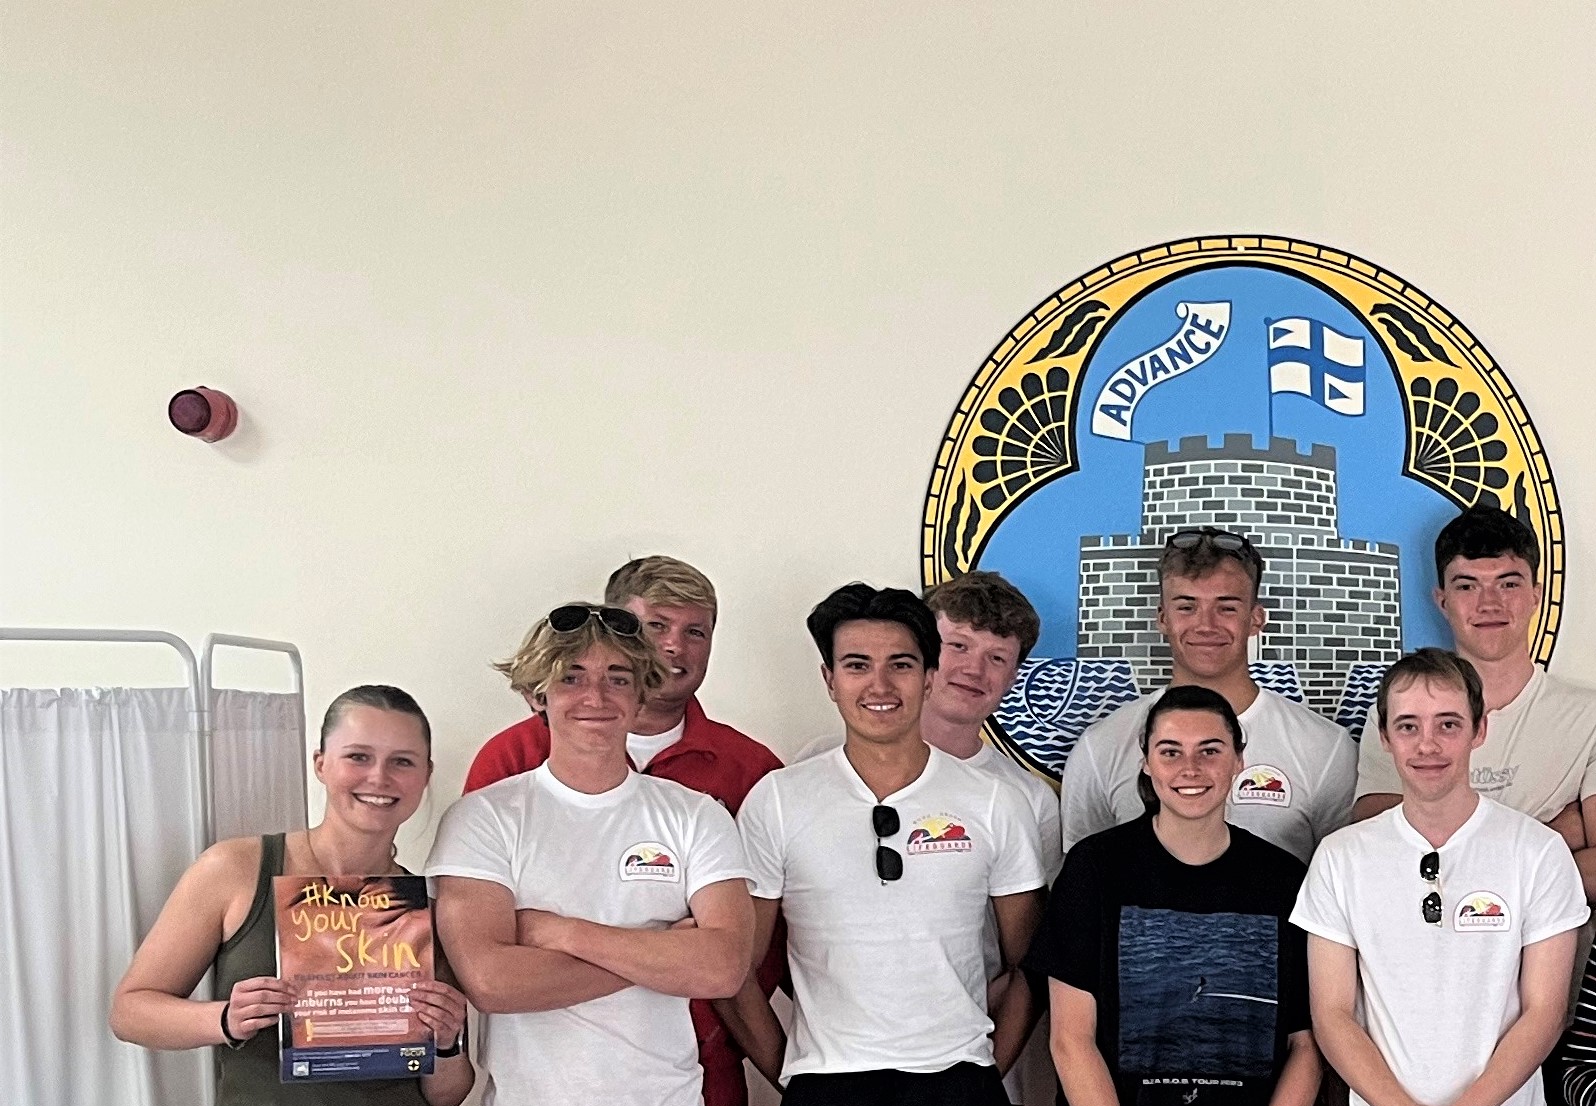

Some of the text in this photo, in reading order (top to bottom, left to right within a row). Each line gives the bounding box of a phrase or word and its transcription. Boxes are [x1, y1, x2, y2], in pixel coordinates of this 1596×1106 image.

[1099, 313, 1225, 427] ADVANCE
[301, 882, 390, 909] #Know
[291, 909, 364, 941] your
[363, 986, 394, 995] more
